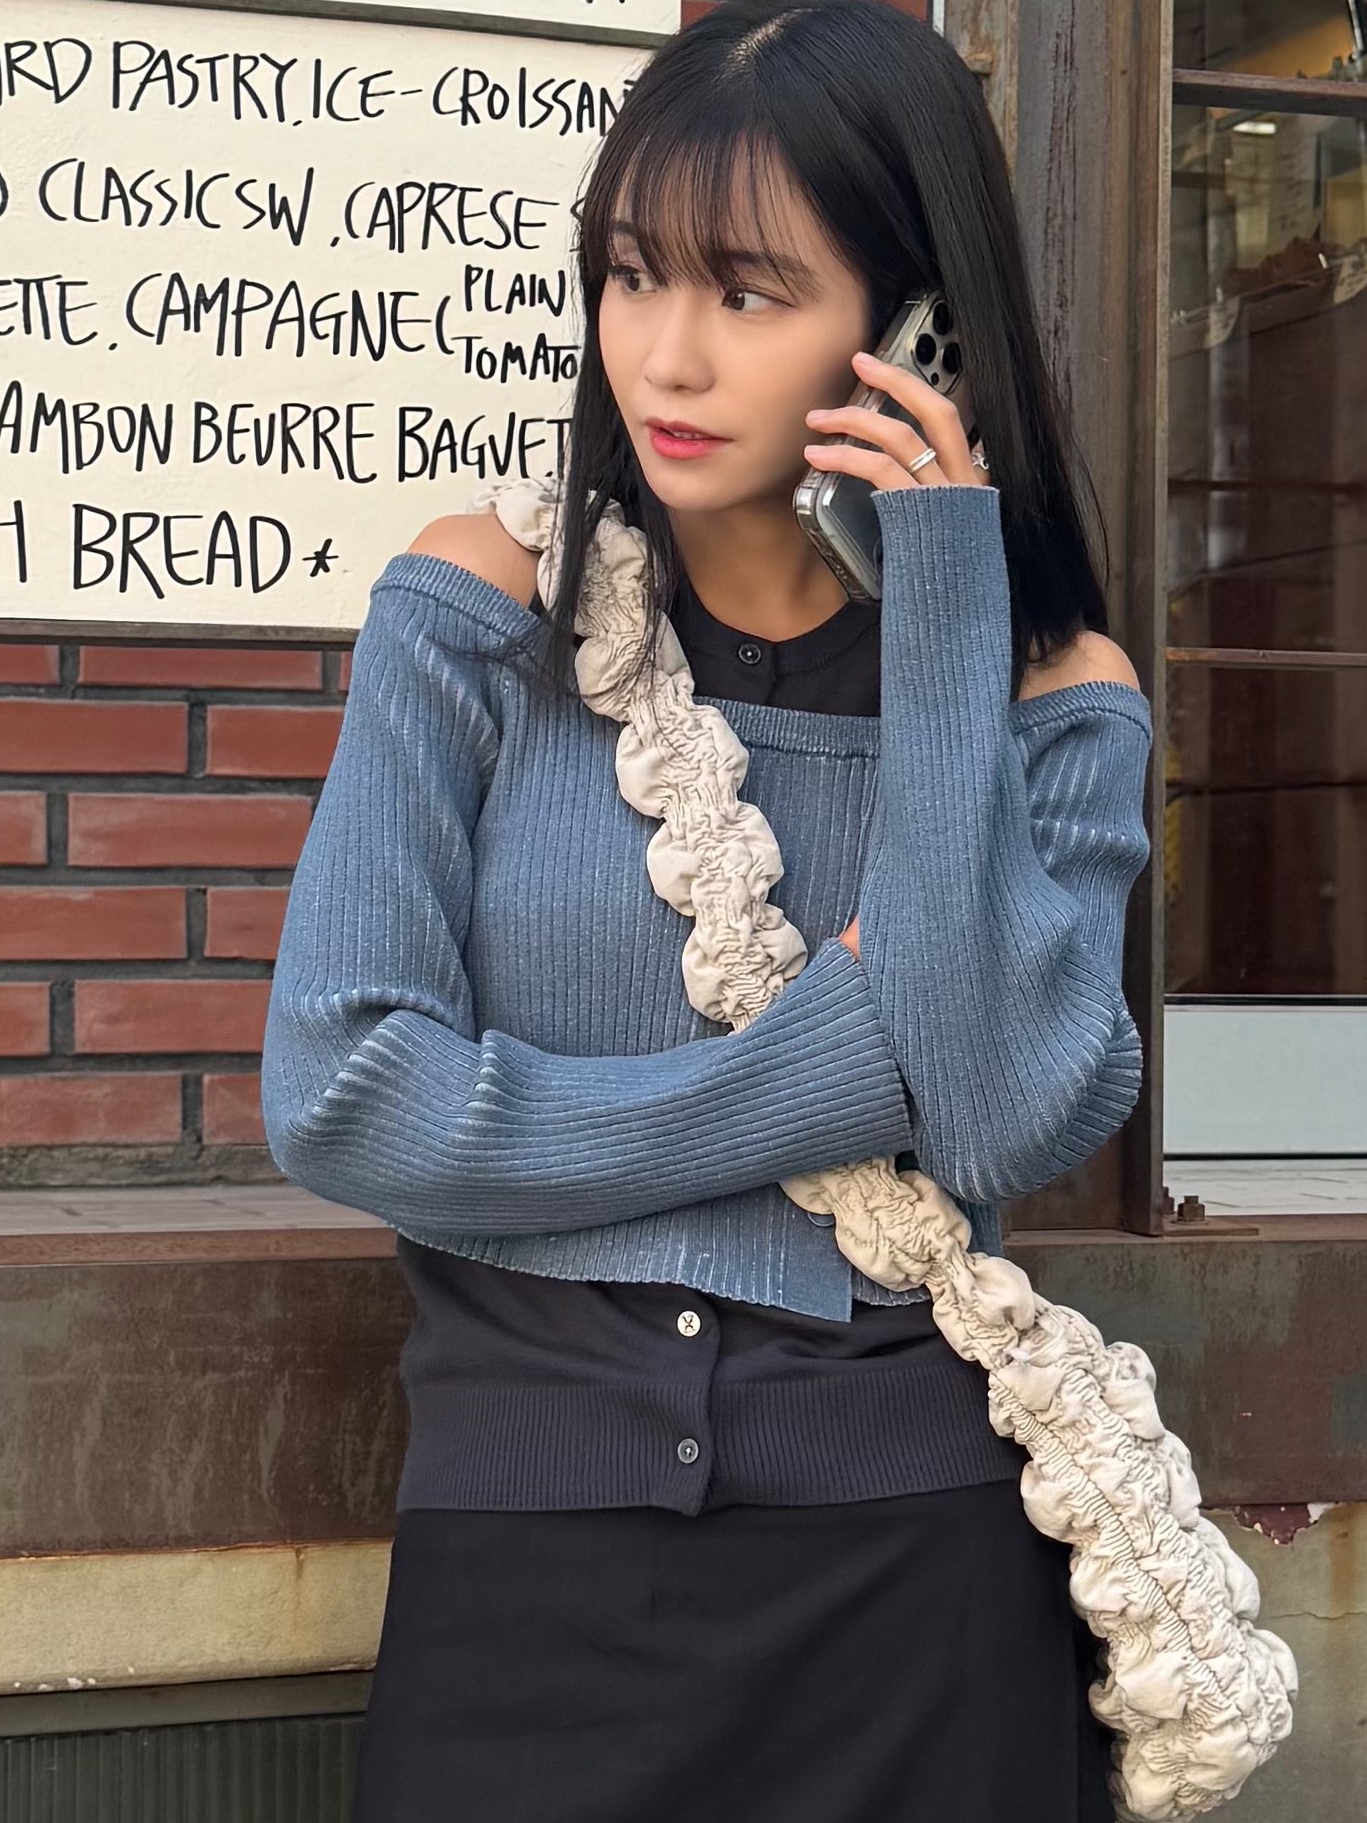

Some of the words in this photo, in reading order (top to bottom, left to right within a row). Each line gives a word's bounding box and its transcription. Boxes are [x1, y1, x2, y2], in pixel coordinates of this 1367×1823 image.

[37, 156, 231, 230] CLASSIC
[343, 180, 561, 255] CAPRESE
[463, 262, 568, 319] PLAIN
[449, 331, 583, 385] TOMATO
[191, 400, 379, 485] BEURRE
[71, 502, 293, 601] BREAD
